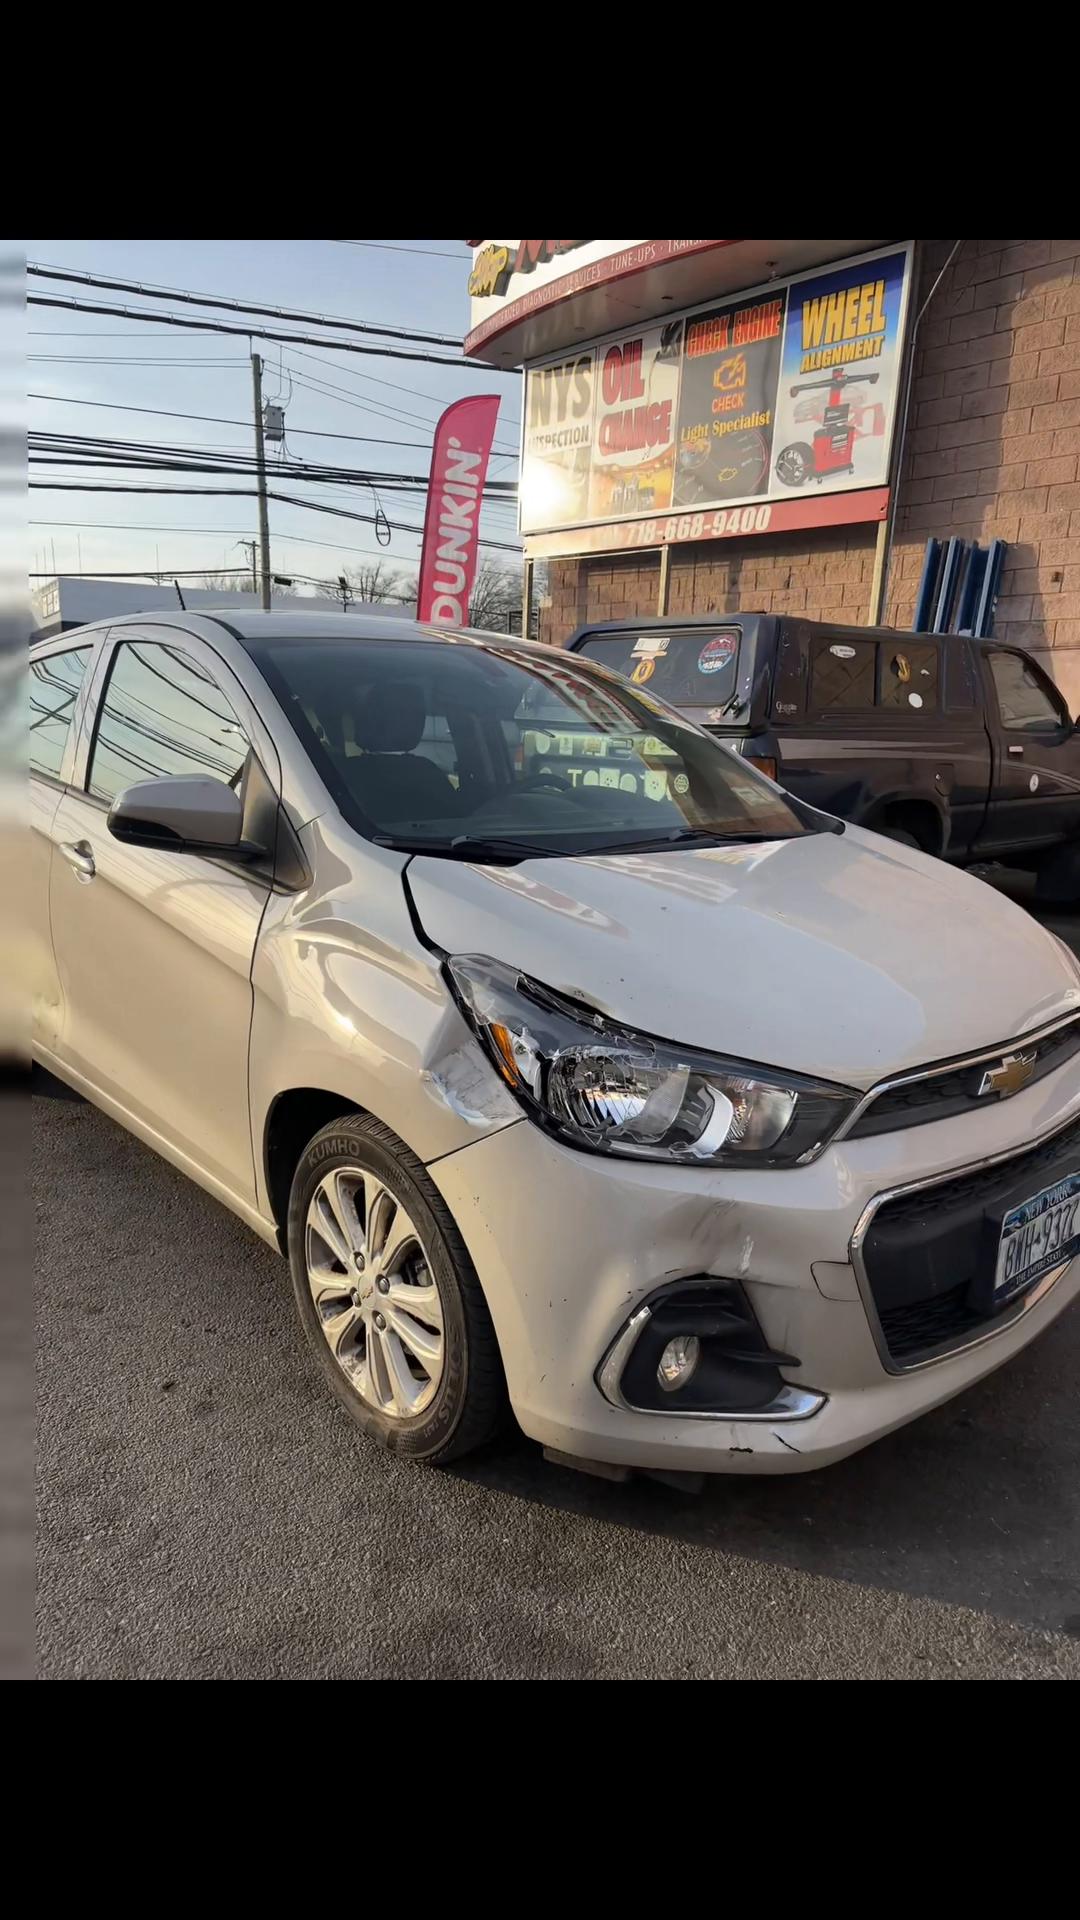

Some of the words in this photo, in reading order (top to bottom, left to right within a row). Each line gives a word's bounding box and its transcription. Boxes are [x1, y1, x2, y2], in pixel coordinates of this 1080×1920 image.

[610, 243, 656, 272] TUNE-UPS
[686, 313, 731, 360] CHECK
[732, 298, 782, 348] ENGINE
[802, 279, 886, 351] WHEEL
[602, 338, 645, 406] OIL
[800, 335, 885, 375] ALIGNMENT
[530, 356, 592, 428] NYS
[711, 392, 746, 413] CHECK
[528, 424, 590, 449] SPECTION
[599, 399, 672, 457] CHANGE
[681, 423, 709, 443] Light
[711, 409, 771, 437] Specialist
[430, 436, 482, 627] DUNKIN'
[626, 504, 772, 545] 718-668-9400
[307, 1138, 360, 1168] KUMHO
